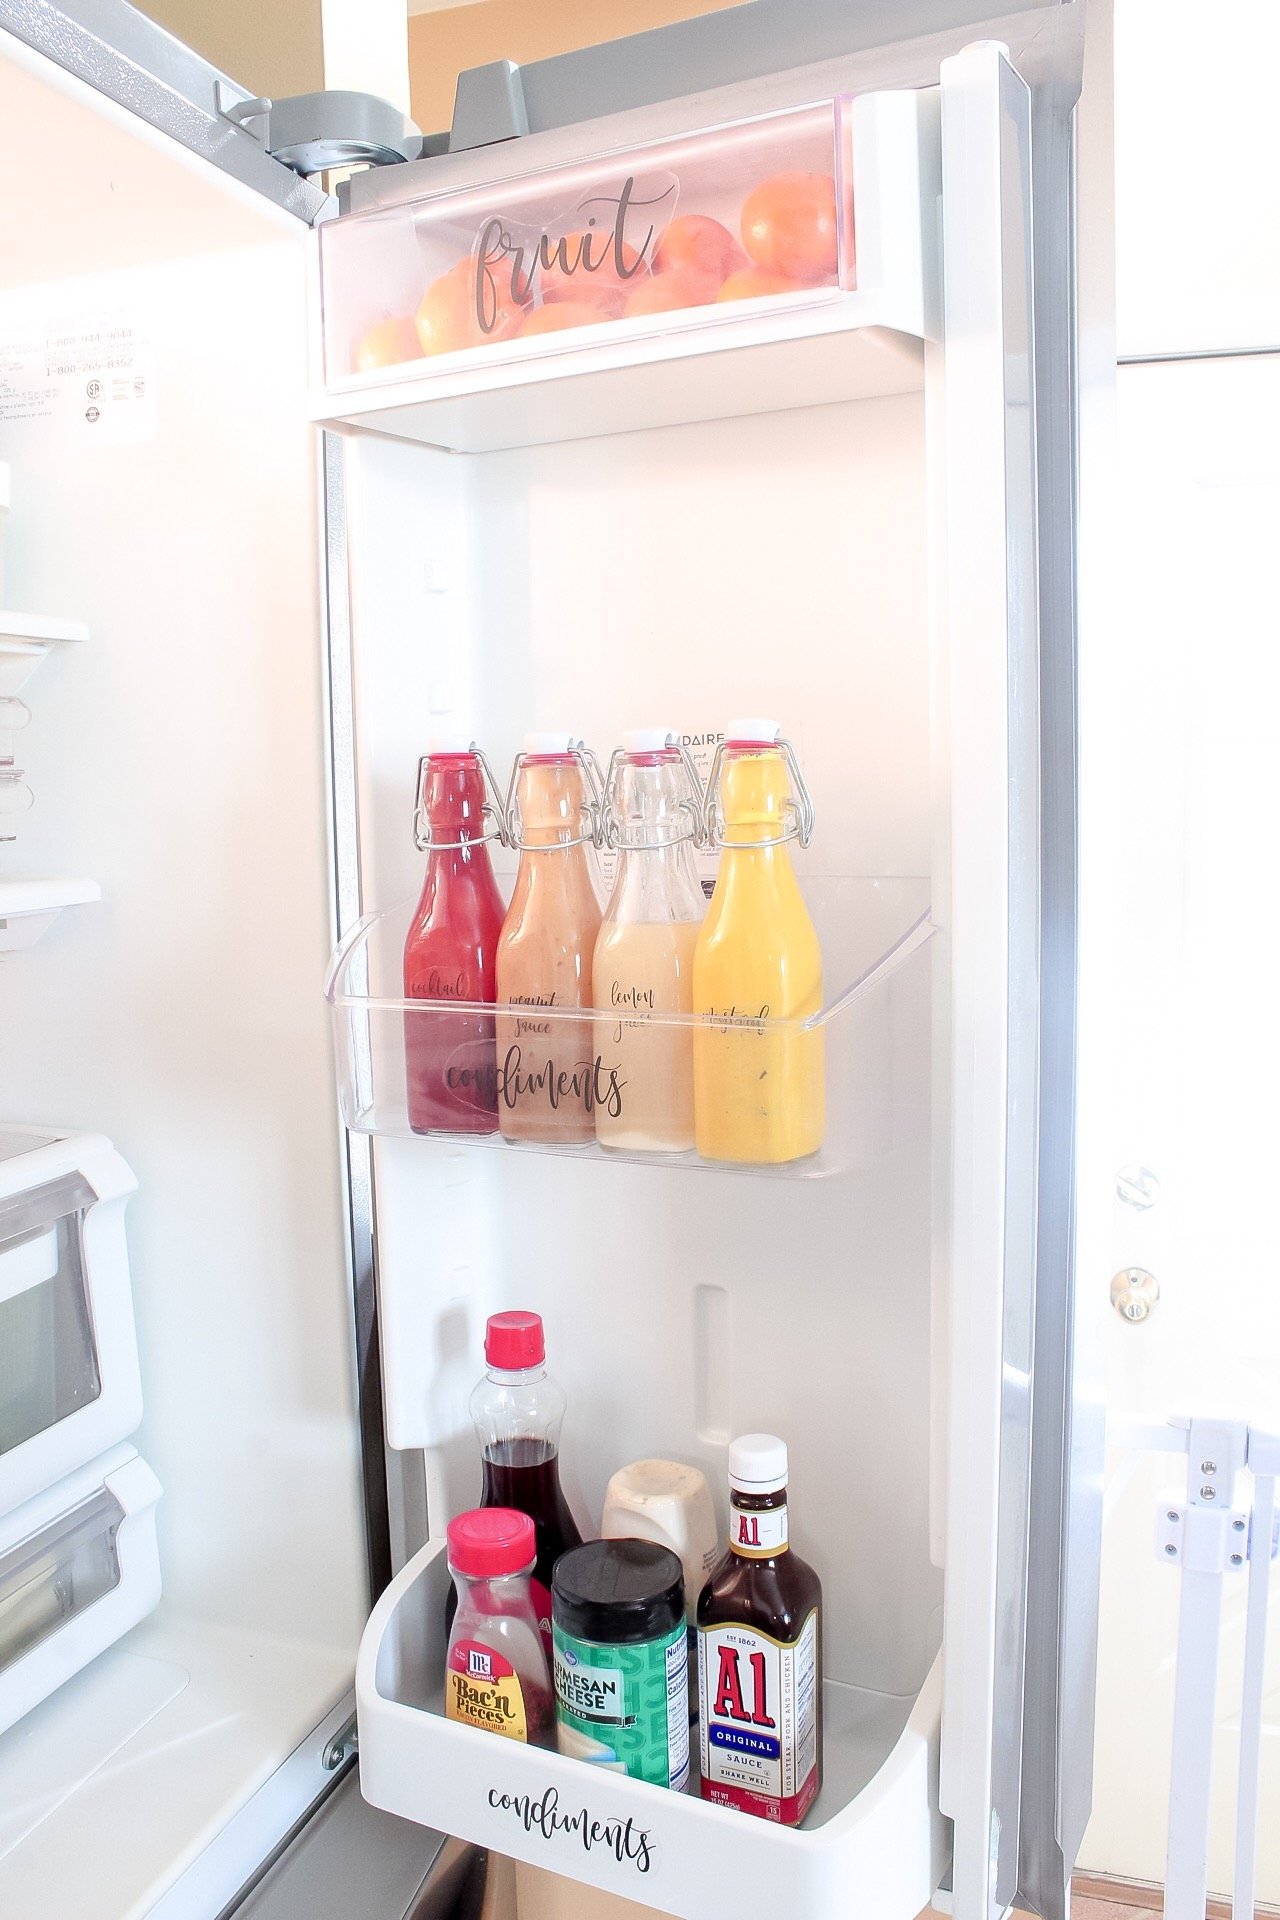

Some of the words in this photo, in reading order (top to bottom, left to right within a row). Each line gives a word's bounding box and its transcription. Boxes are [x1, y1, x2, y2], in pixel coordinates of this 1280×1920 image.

[475, 176, 676, 335] fruit
[411, 969, 465, 997] cocktail
[611, 980, 655, 1009] lemon
[515, 1018, 551, 1038] sauce
[446, 1044, 628, 1118] condiments
[738, 1514, 762, 1547] A1
[738, 1637, 757, 1647] 1862
[713, 1645, 776, 1729] A1
[456, 1696, 505, 1724] Pieces
[716, 1730, 773, 1752] ORIGINAL
[726, 1753, 763, 1769] SAUCE
[720, 1769, 746, 1779] SHAKE
[748, 1776, 770, 1787] WELL
[488, 1786, 657, 1873] condiments
